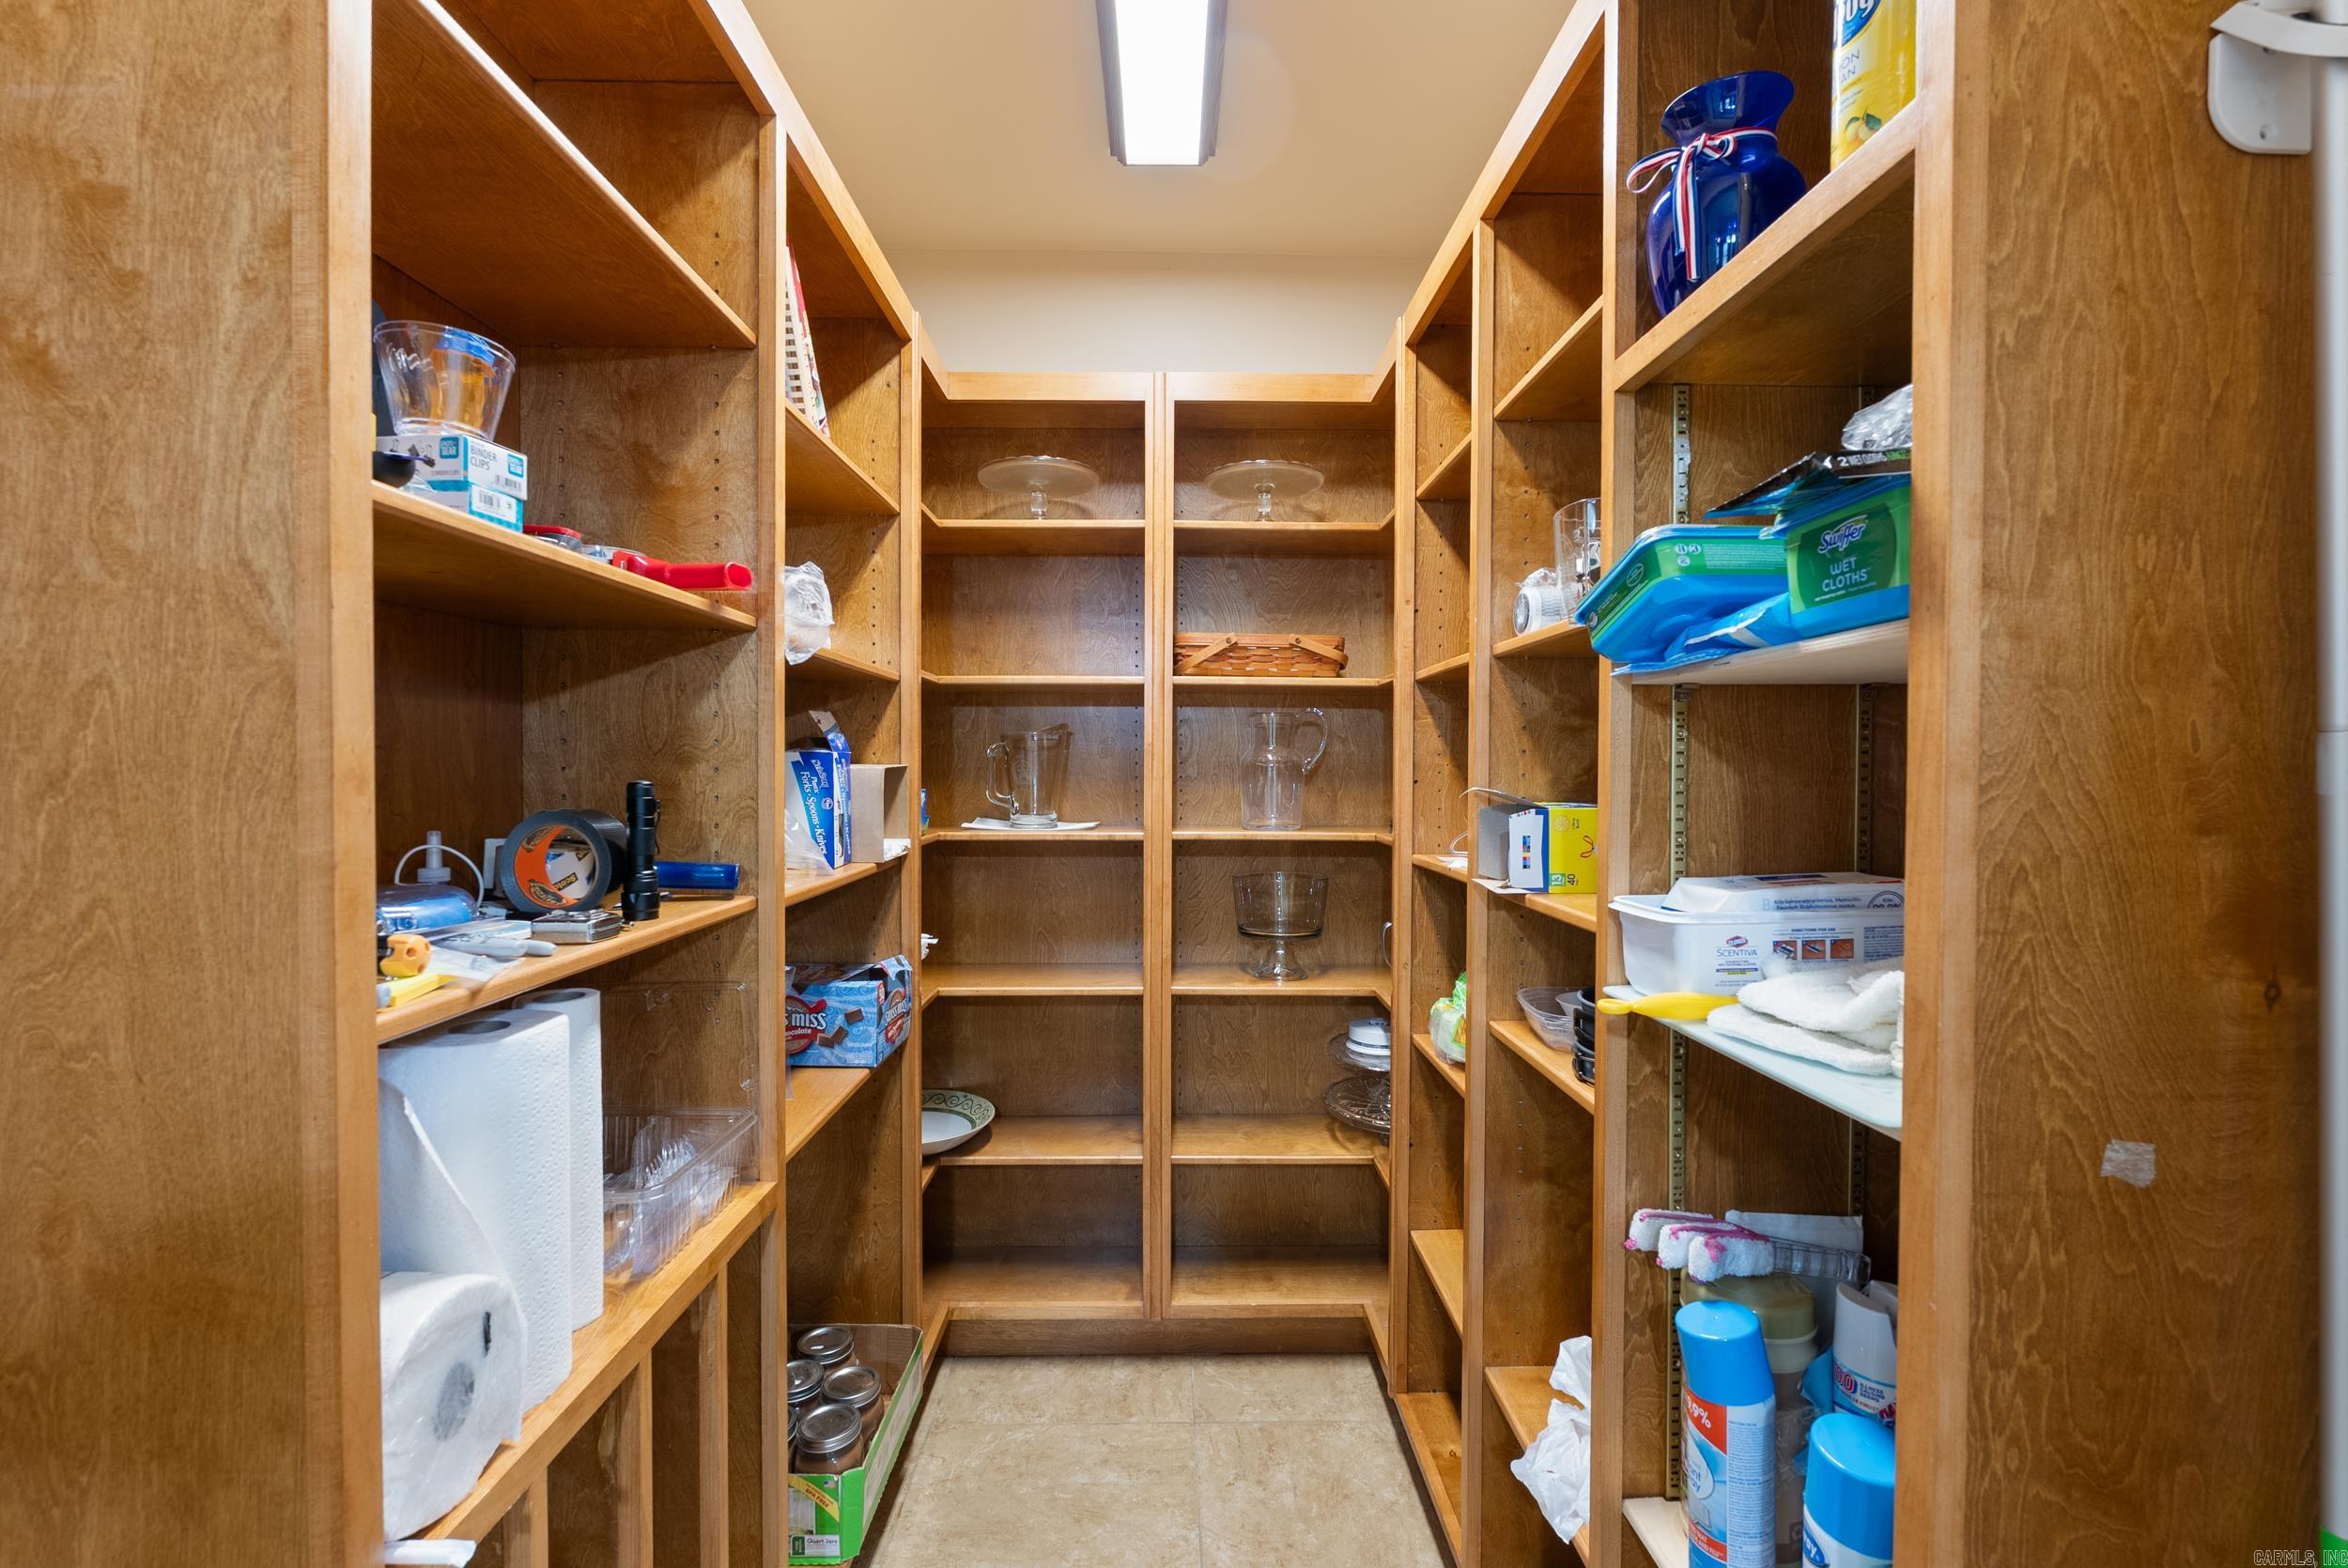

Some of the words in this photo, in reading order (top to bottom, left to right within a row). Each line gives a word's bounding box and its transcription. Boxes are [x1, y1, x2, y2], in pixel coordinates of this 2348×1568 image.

[471, 445, 497, 462] BINDER
[1837, 456, 1849, 467] 2
[471, 456, 490, 470] CLIPS
[1817, 523, 1867, 554] Swiffer
[1830, 557, 1857, 576] WET
[1822, 568, 1868, 592] CLOTHS
[800, 771, 812, 793] Forks
[805, 796, 820, 825] Spoons
[814, 827, 827, 854] Knives
[1552, 874, 1562, 886] 13
[1567, 873, 1576, 885] 40
[1716, 948, 1758, 958] SCENTIVA
[816, 1496, 830, 1508] FREE
